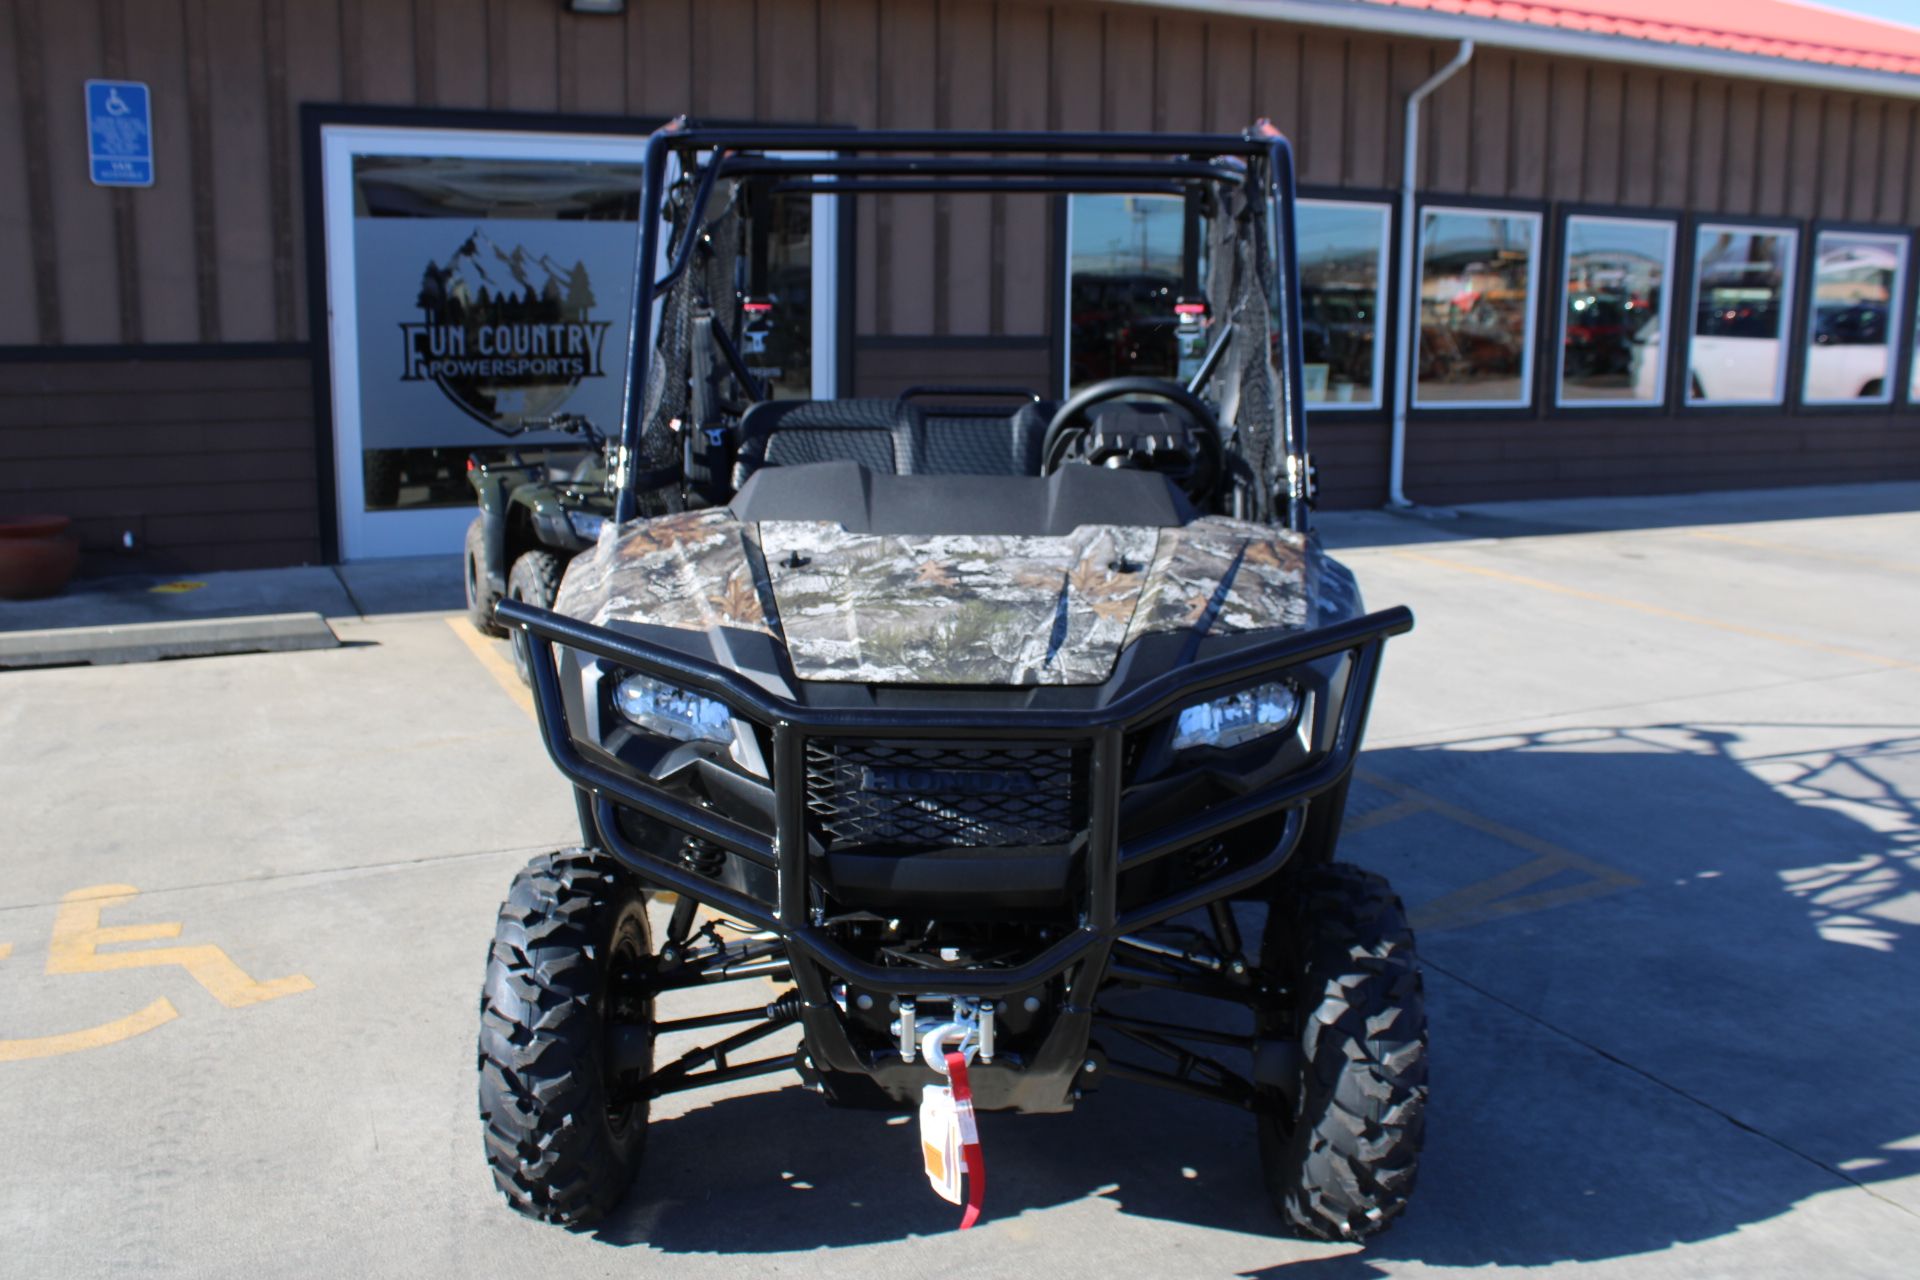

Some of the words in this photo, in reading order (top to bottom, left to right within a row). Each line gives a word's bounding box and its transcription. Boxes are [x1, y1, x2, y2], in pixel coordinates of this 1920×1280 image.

[399, 323, 466, 379] FUN
[478, 322, 612, 376] COUNTRY
[429, 358, 584, 377] POWERSPORTS
[860, 766, 1037, 792] HONDA
